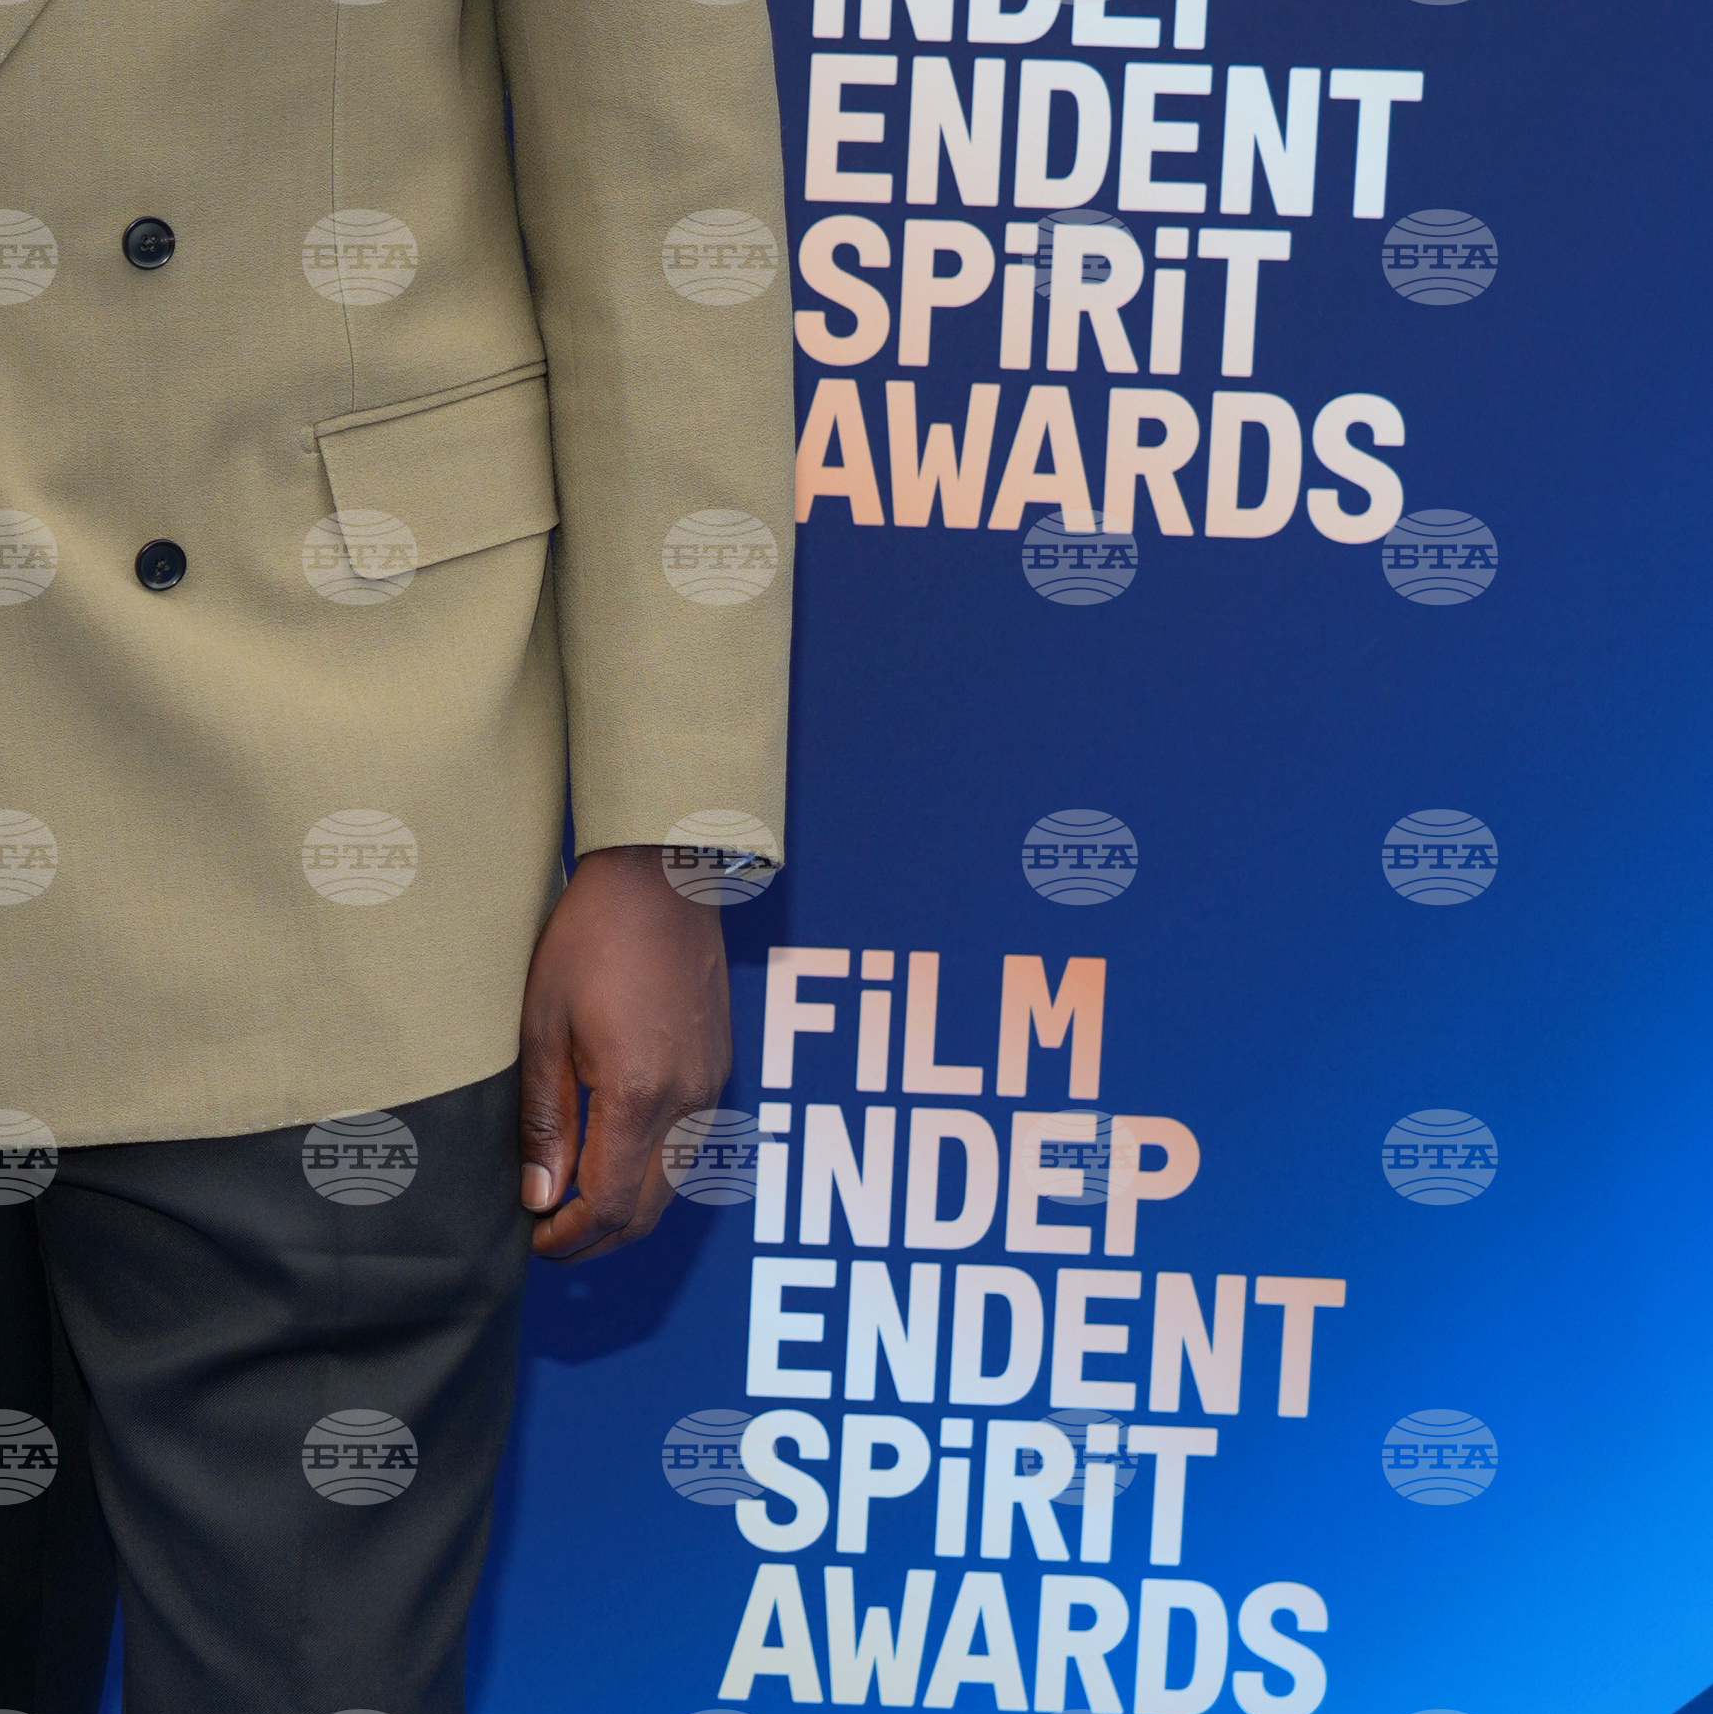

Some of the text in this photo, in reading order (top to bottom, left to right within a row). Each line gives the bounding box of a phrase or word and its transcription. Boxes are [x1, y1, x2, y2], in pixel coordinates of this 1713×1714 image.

[804, 53, 1424, 219] ENDENT
[793, 215, 1291, 377] SPiRiT
[794, 379, 1406, 545] AWARDS
[760, 946, 1106, 1099] FiLM
[754, 1101, 1200, 1256] iNDEP
[745, 1256, 1346, 1418] ENDENT
[735, 1409, 1217, 1566] SPiRiT
